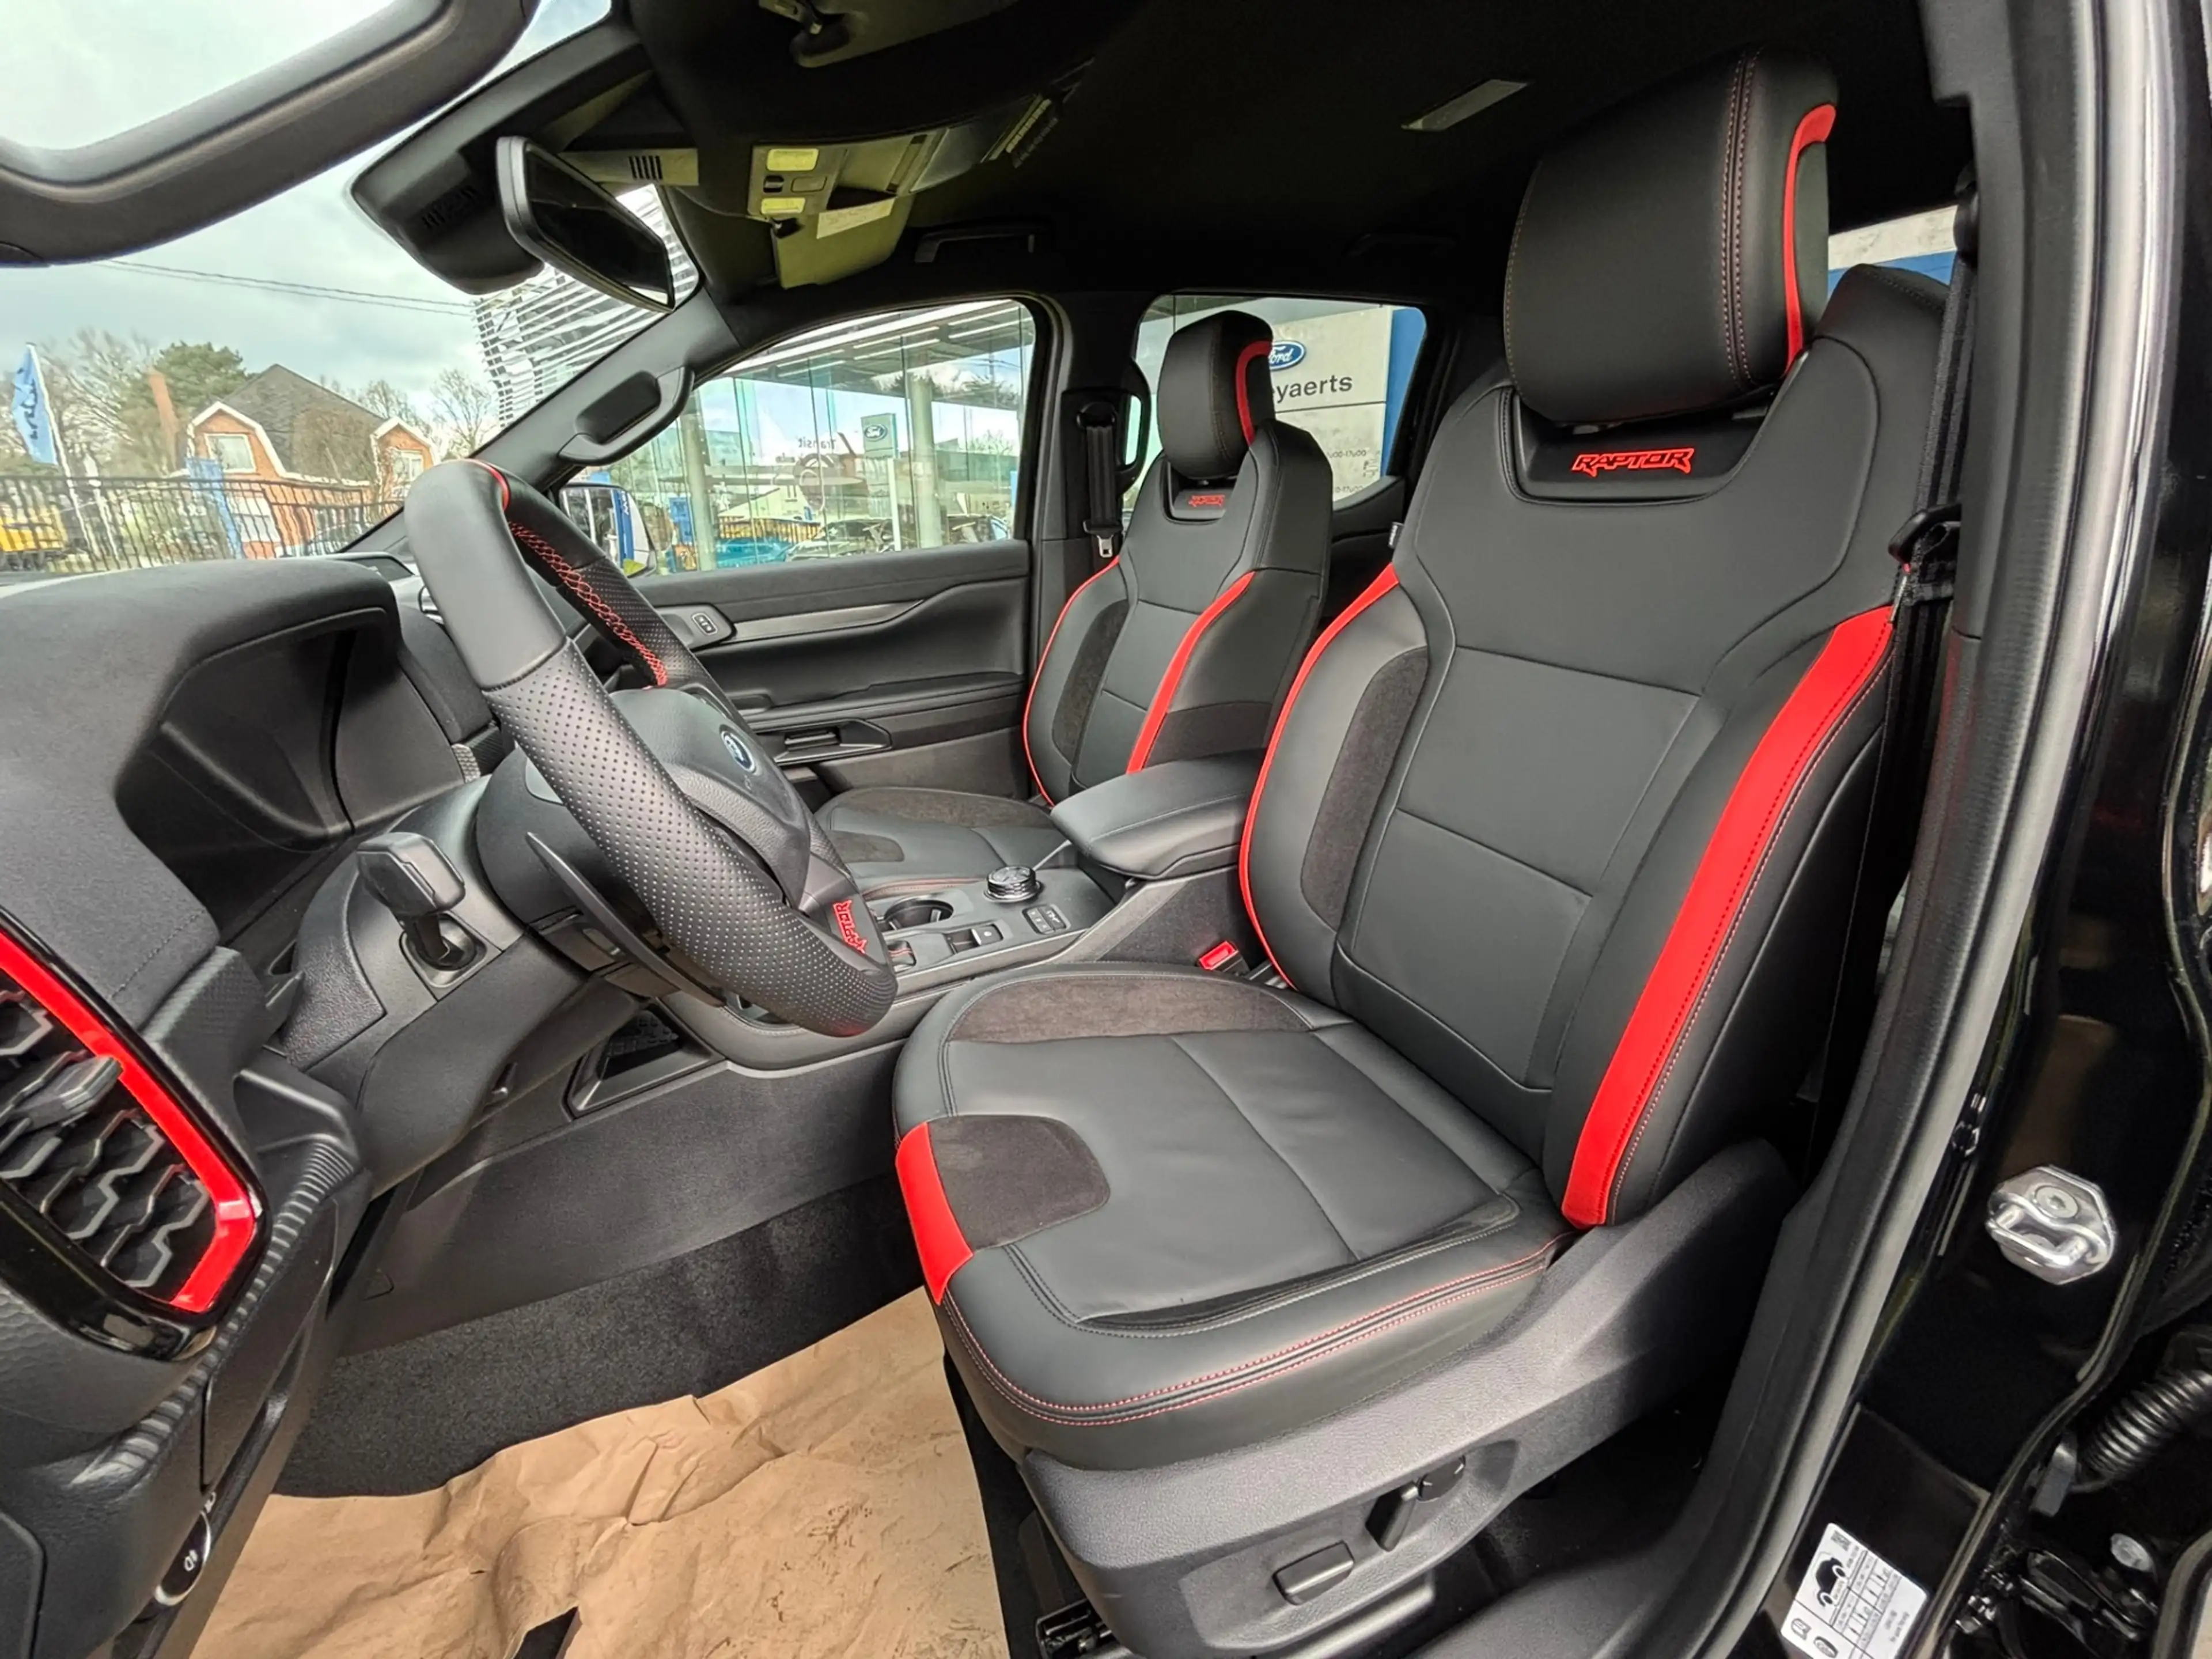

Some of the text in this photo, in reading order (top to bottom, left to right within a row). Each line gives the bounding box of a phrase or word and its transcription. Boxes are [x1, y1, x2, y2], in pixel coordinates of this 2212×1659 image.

[1273, 374, 1353, 403] yaerts
[1571, 448, 1695, 477] RAPTOR
[833, 900, 867, 954] RAPTOR
